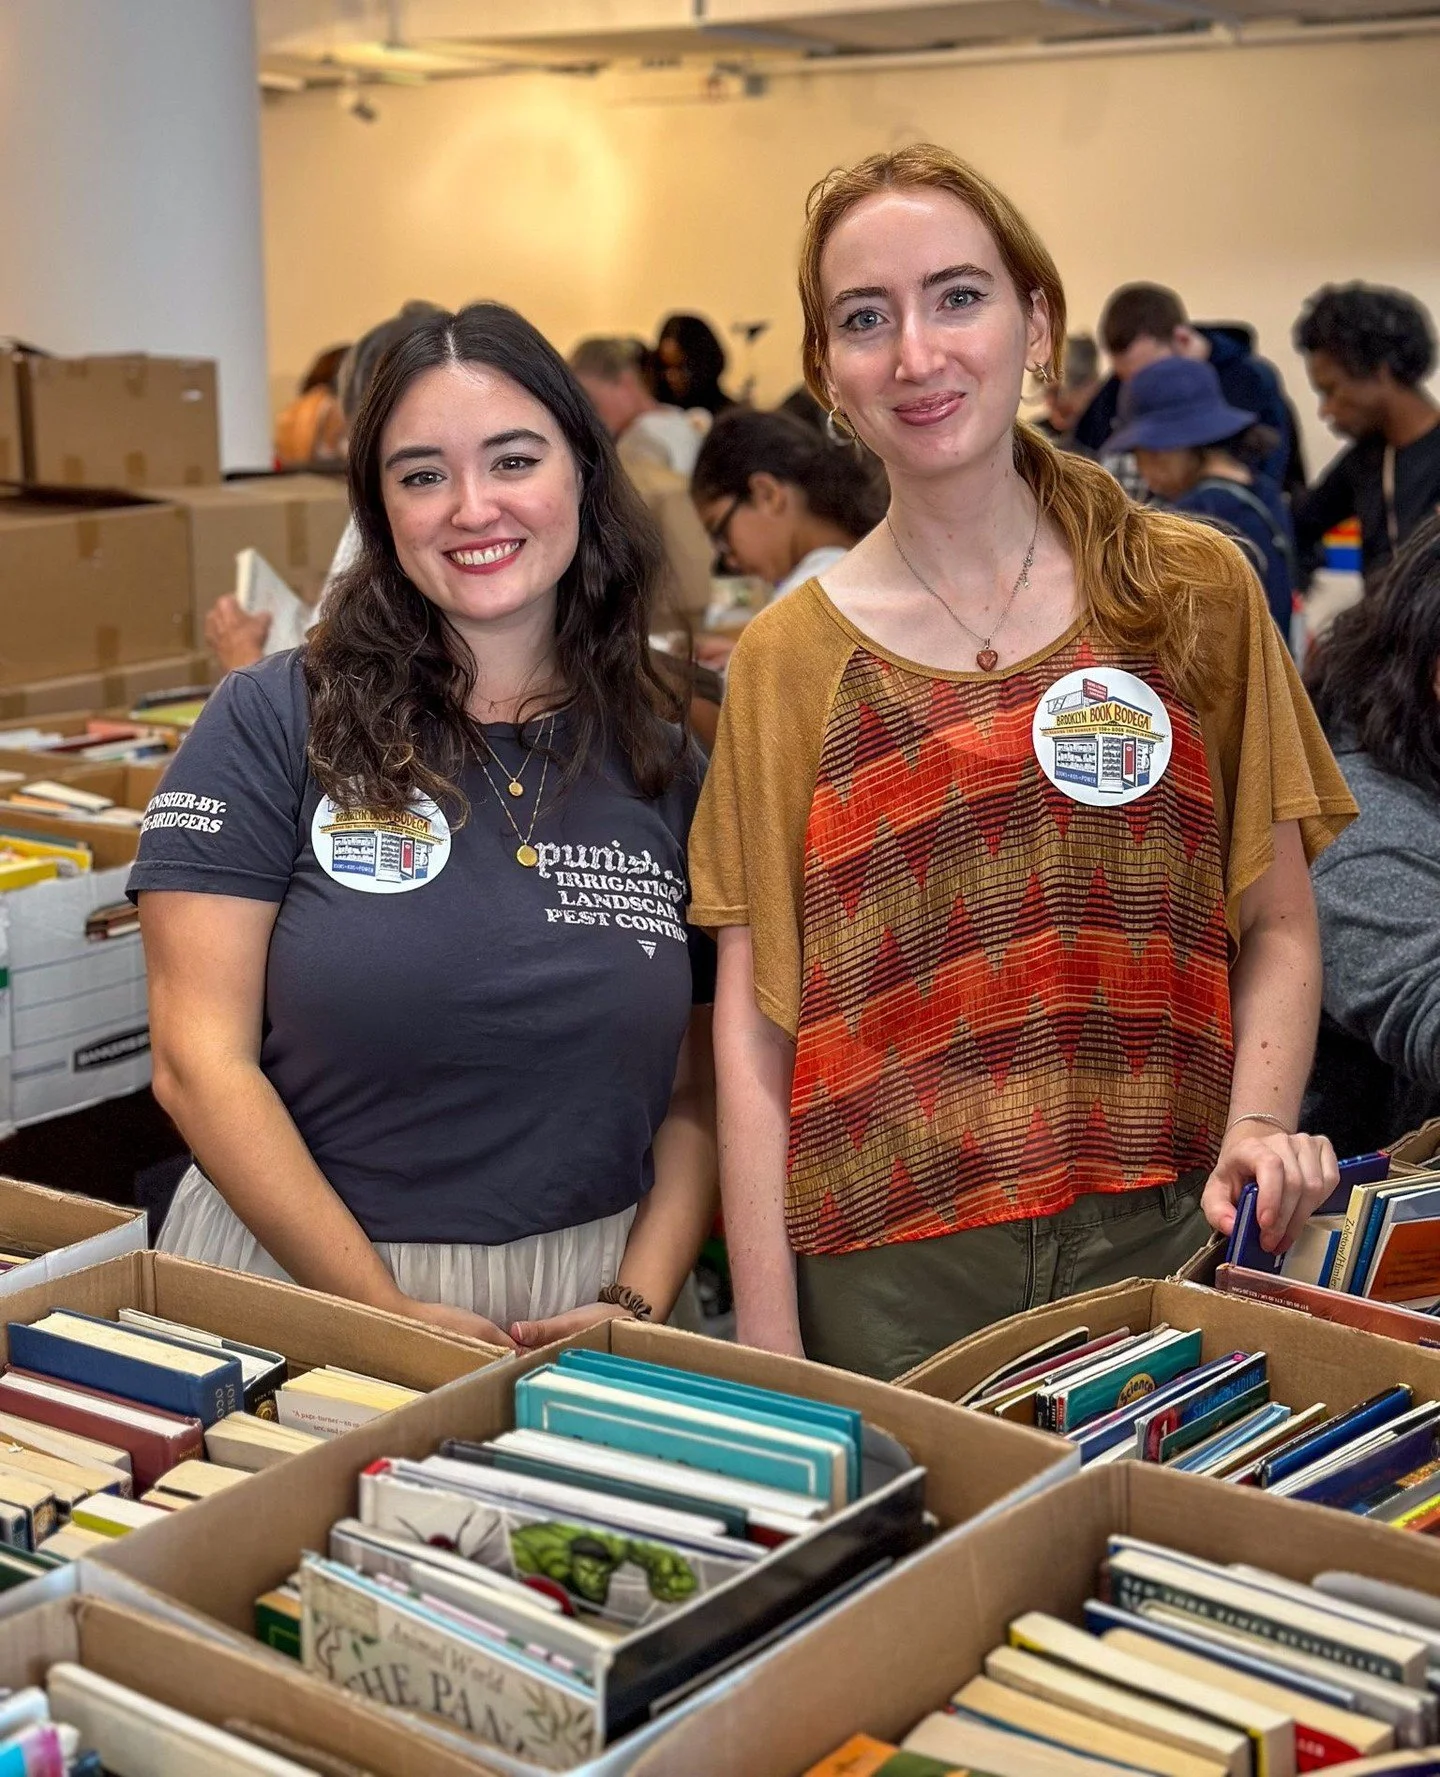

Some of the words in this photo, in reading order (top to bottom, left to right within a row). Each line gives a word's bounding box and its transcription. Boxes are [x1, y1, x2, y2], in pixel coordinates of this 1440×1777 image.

[1056, 710, 1087, 726] BROOKLYN
[1089, 703, 1113, 722] BOOK
[1114, 703, 1150, 730] BODEGA
[557, 890, 681, 924] LANDSCAP
[544, 908, 611, 927] PEST
[614, 913, 688, 944] CONTRO
[1330, 1217, 1356, 1288] Zolotow/Himler
[1119, 1379, 1154, 1402] Science
[1214, 1606, 1271, 1638] TIMES
[1276, 1627, 1394, 1677] BESTSELLER
